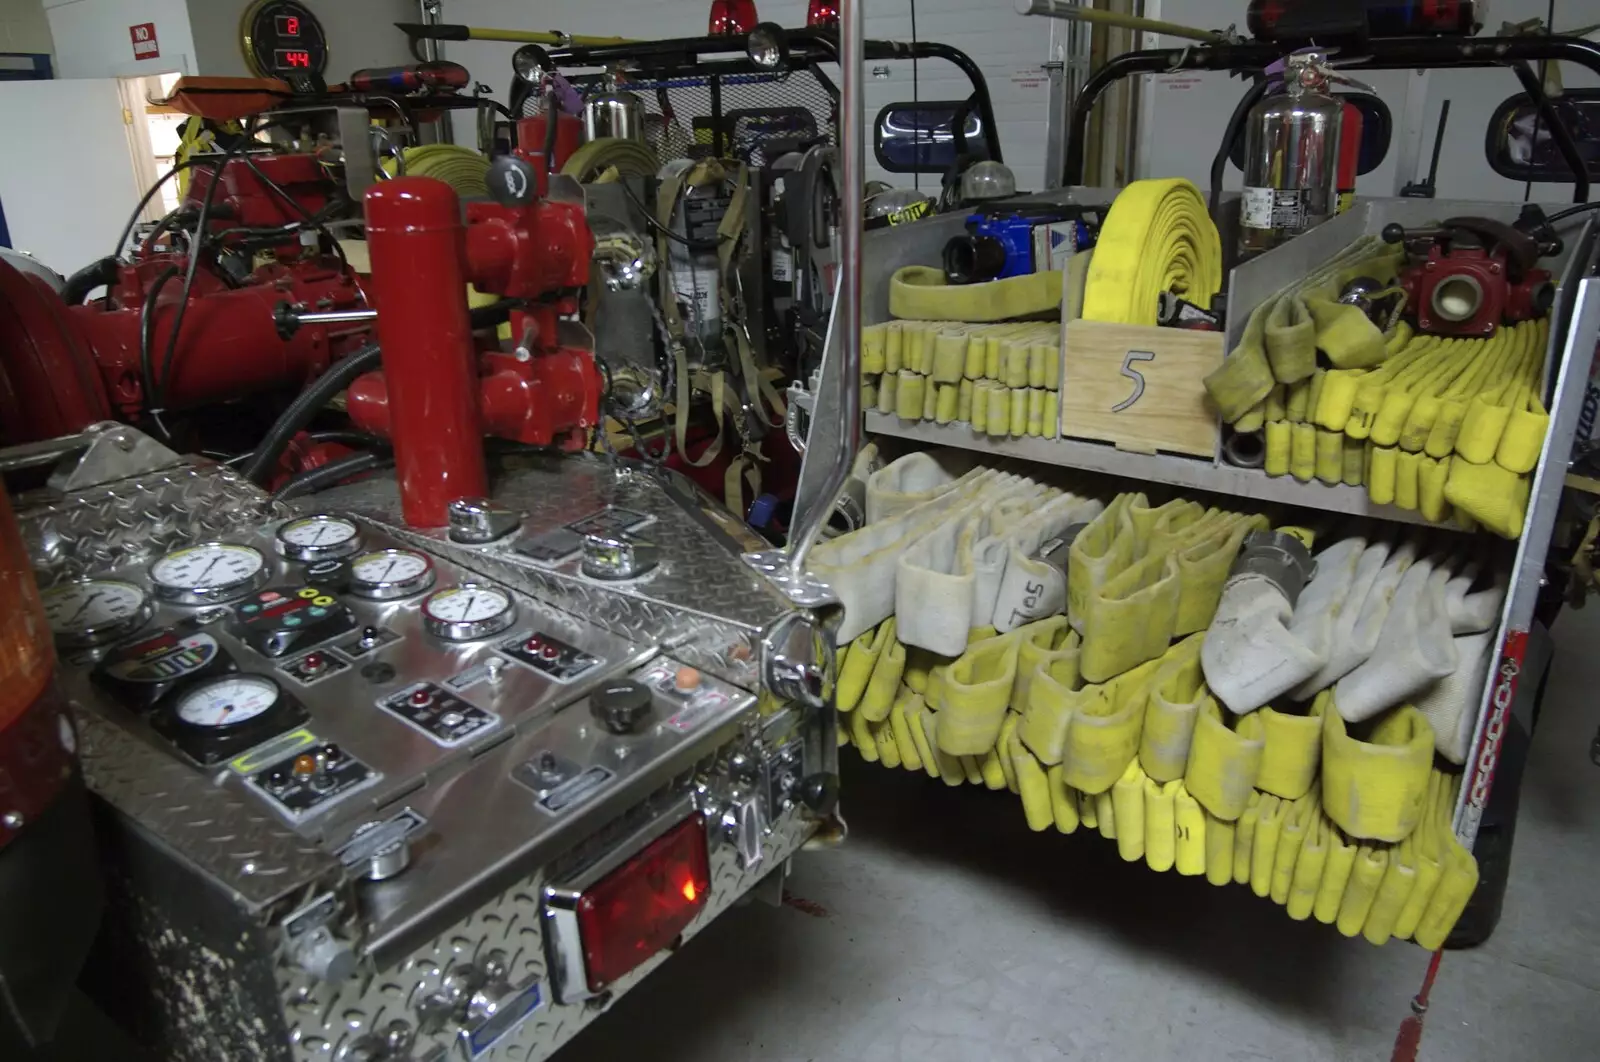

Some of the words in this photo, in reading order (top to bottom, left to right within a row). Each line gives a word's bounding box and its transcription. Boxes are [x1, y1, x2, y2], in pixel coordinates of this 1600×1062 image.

[287, 18, 299, 34] 2
[135, 27, 149, 41] NO
[286, 52, 309, 67] 44
[1111, 350, 1156, 413] 5
